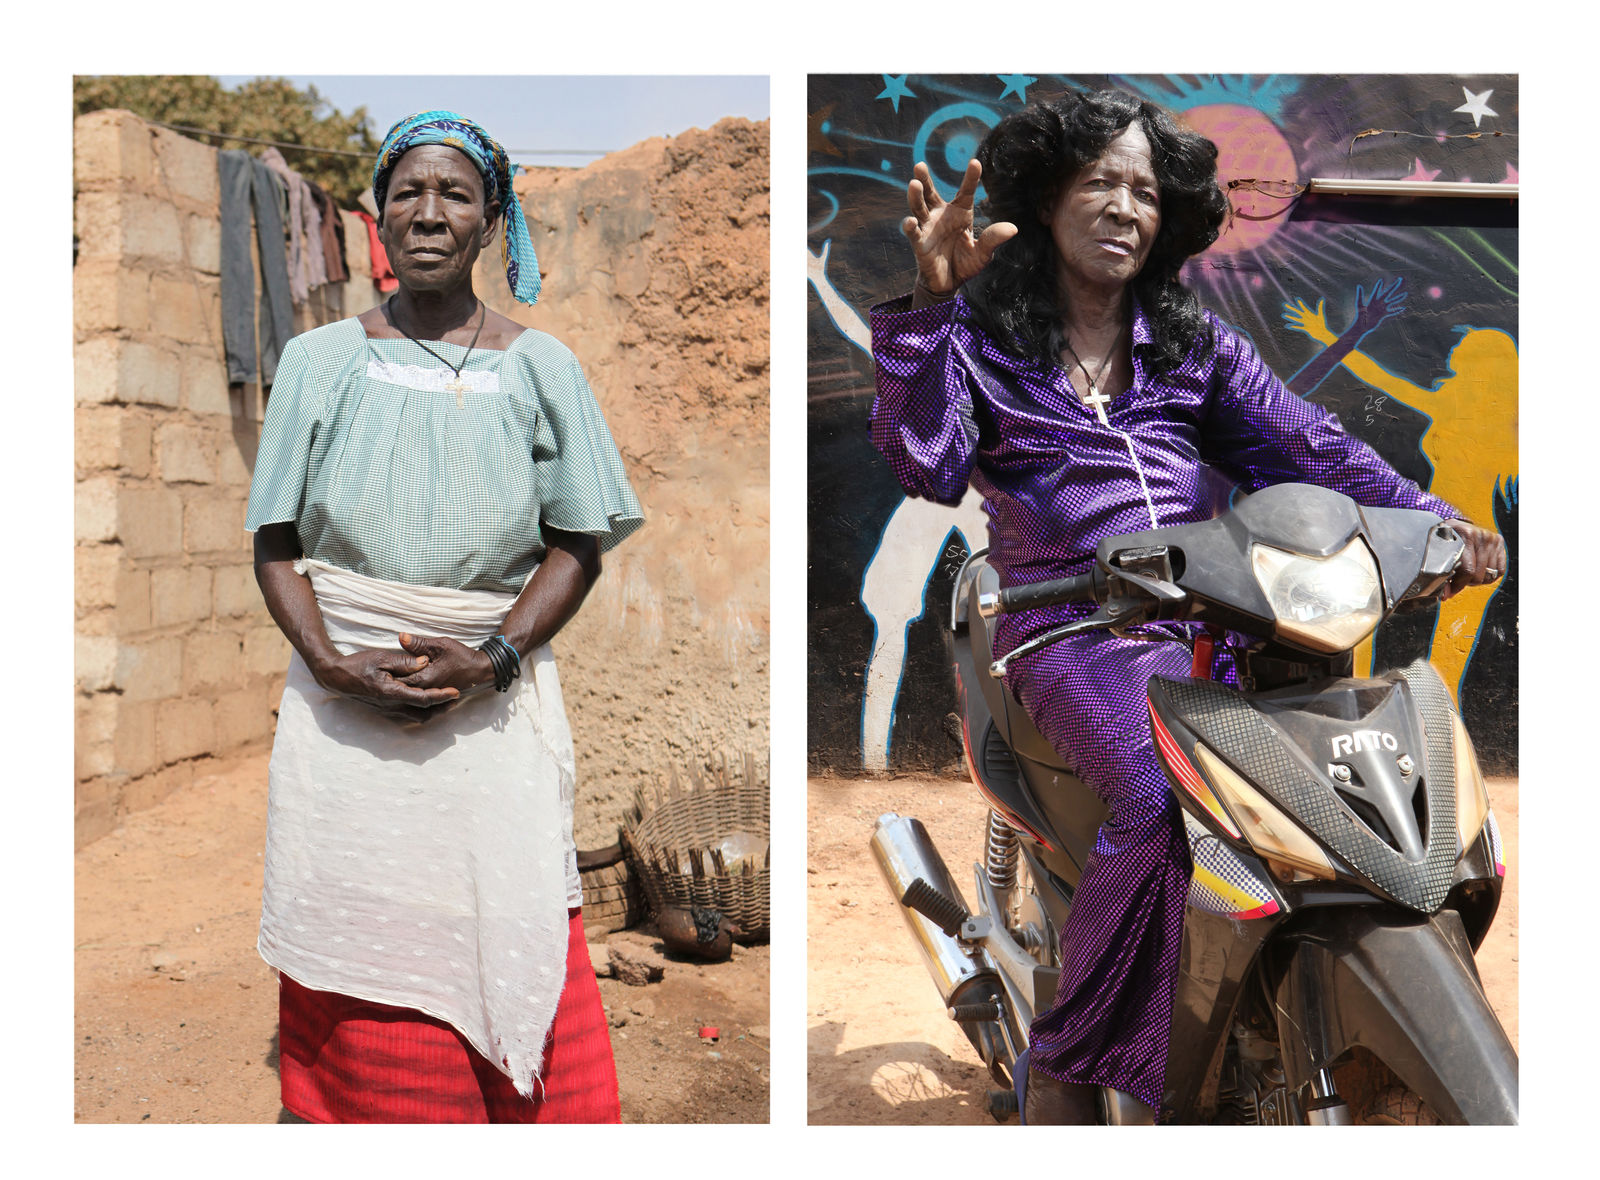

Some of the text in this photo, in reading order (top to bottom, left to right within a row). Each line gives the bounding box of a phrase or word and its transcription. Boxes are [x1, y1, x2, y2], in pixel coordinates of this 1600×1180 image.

[1364, 394, 1388, 412] 28
[1365, 414, 1375, 427] 5
[1331, 730, 1398, 759] RATO
